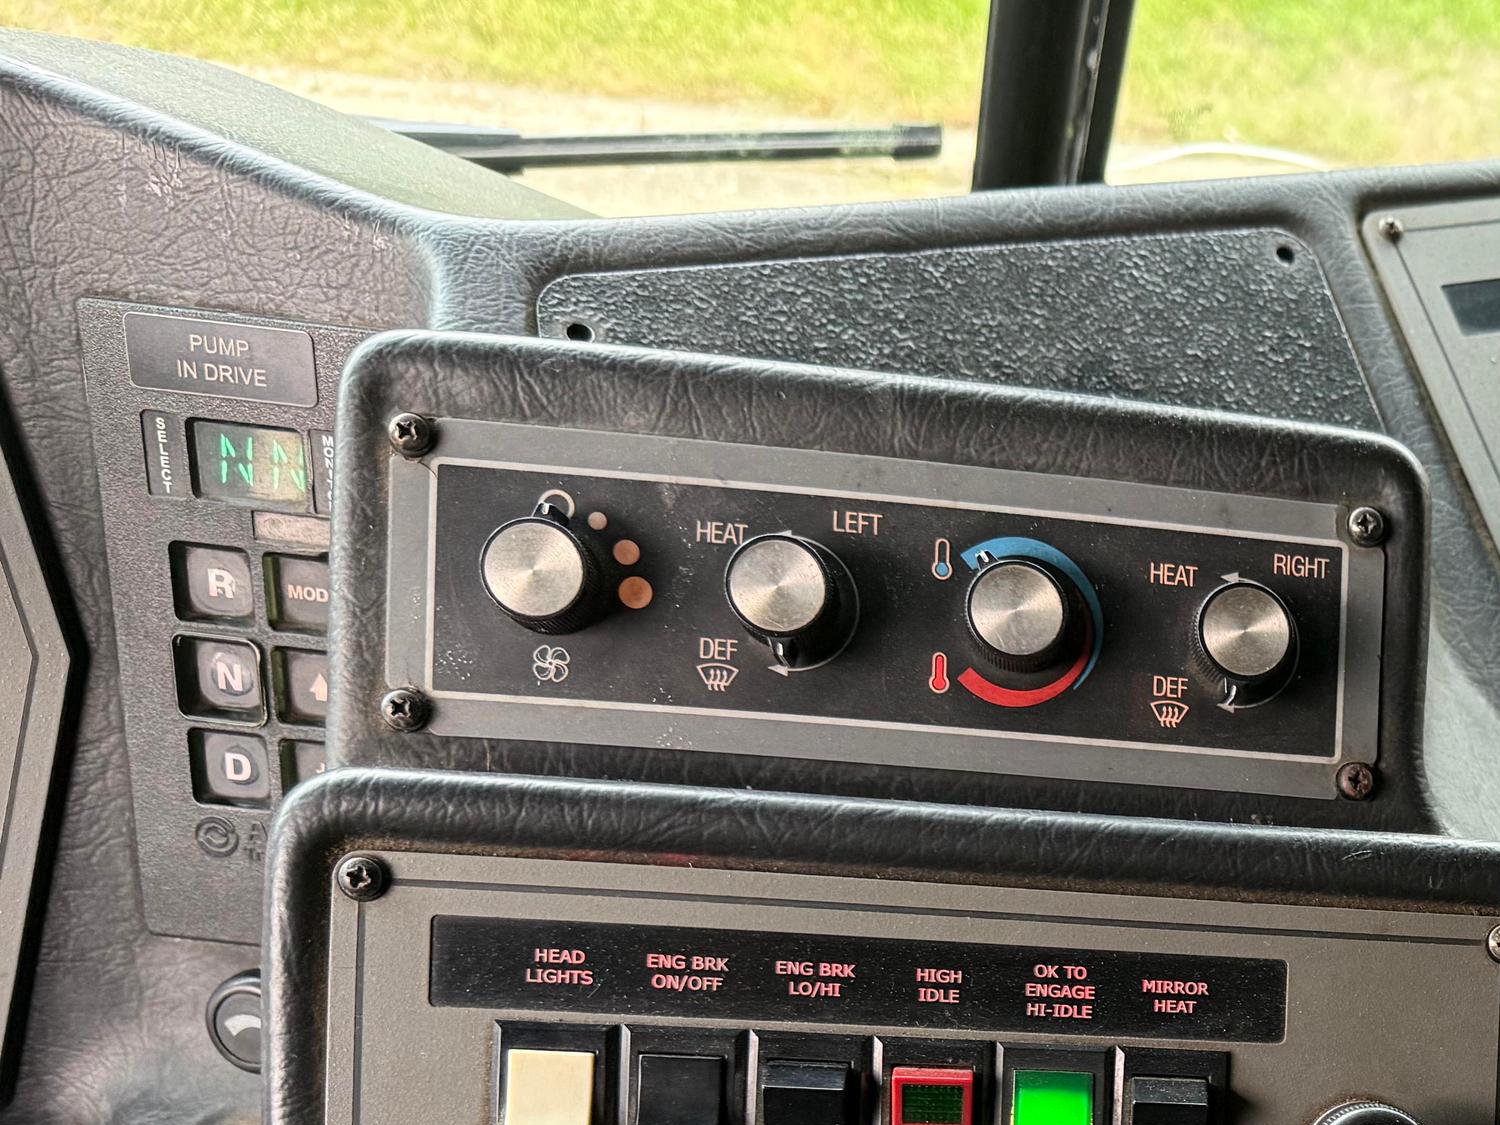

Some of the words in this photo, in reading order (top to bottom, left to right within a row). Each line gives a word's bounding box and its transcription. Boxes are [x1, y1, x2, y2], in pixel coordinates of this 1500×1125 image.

[189, 334, 249, 357] PUMP
[177, 359, 198, 379] IN
[204, 362, 267, 388] DRIVE
[155, 417, 173, 493] SELECT
[696, 520, 748, 545] HEAT
[832, 510, 883, 536] LEFT
[1150, 562, 1198, 587] HEAT
[1273, 553, 1330, 579] RIGHT
[207, 568, 236, 599] R
[287, 584, 329, 603] MOD
[699, 637, 738, 661] DEF
[216, 661, 243, 691] N
[1153, 675, 1188, 698] DEF
[224, 752, 252, 782] D
[534, 948, 586, 965] HEAD
[646, 953, 687, 970] ENG
[691, 956, 730, 972] BRK
[525, 968, 594, 986] LIGHTS
[774, 960, 815, 976] ENG
[818, 962, 857, 979] BRK
[915, 967, 962, 985] HIGH
[1033, 964, 1059, 980] OK
[1063, 965, 1088, 981] TO
[651, 974, 723, 993] ON/OFF
[788, 980, 842, 998] LO/HI
[1025, 982, 1096, 1000] ENGAGE
[1141, 979, 1209, 997] MIRROR
[917, 988, 960, 1004] IDLE
[1026, 1002, 1093, 1020] HI-IDLE
[1153, 999, 1197, 1015] HEAT
